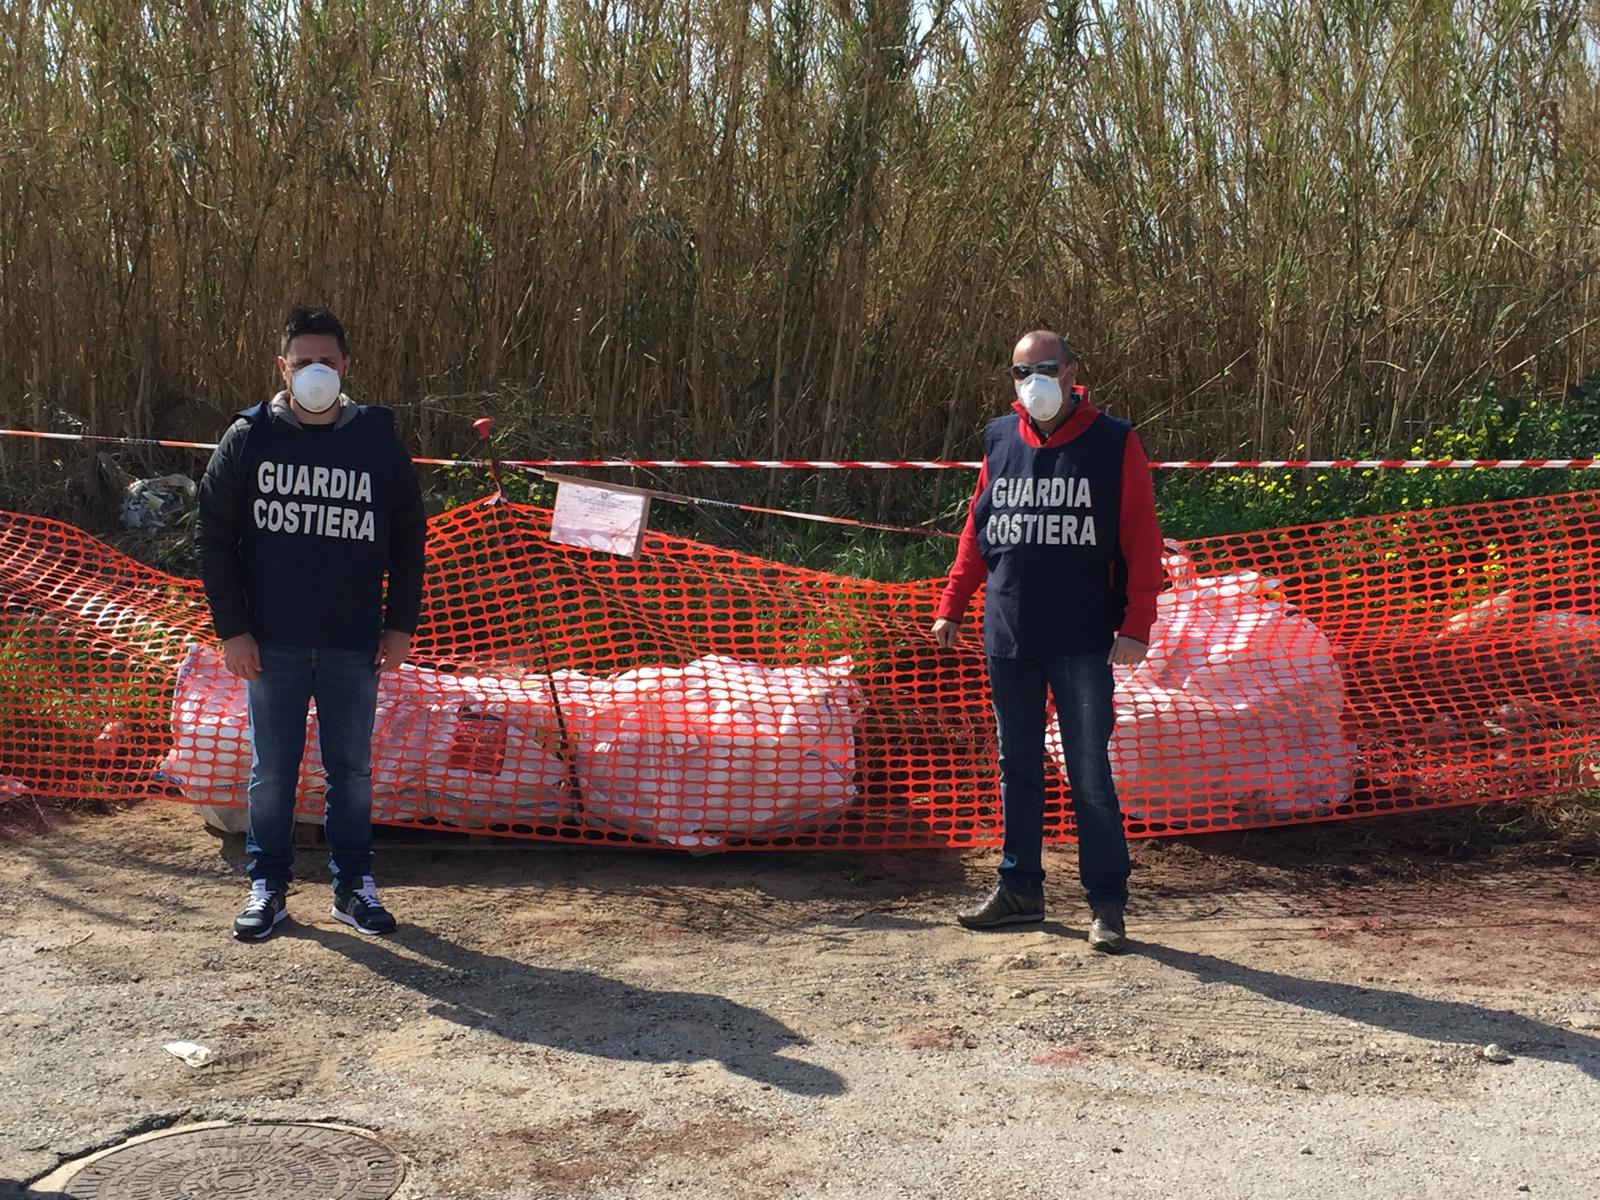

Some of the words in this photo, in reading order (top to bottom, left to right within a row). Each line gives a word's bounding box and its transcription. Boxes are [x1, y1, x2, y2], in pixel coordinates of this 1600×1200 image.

[258, 461, 372, 503] GUARDIA
[992, 477, 1092, 508] GUARDIA
[254, 499, 375, 542] COSTIERA
[986, 514, 1097, 546] COSTIERA
